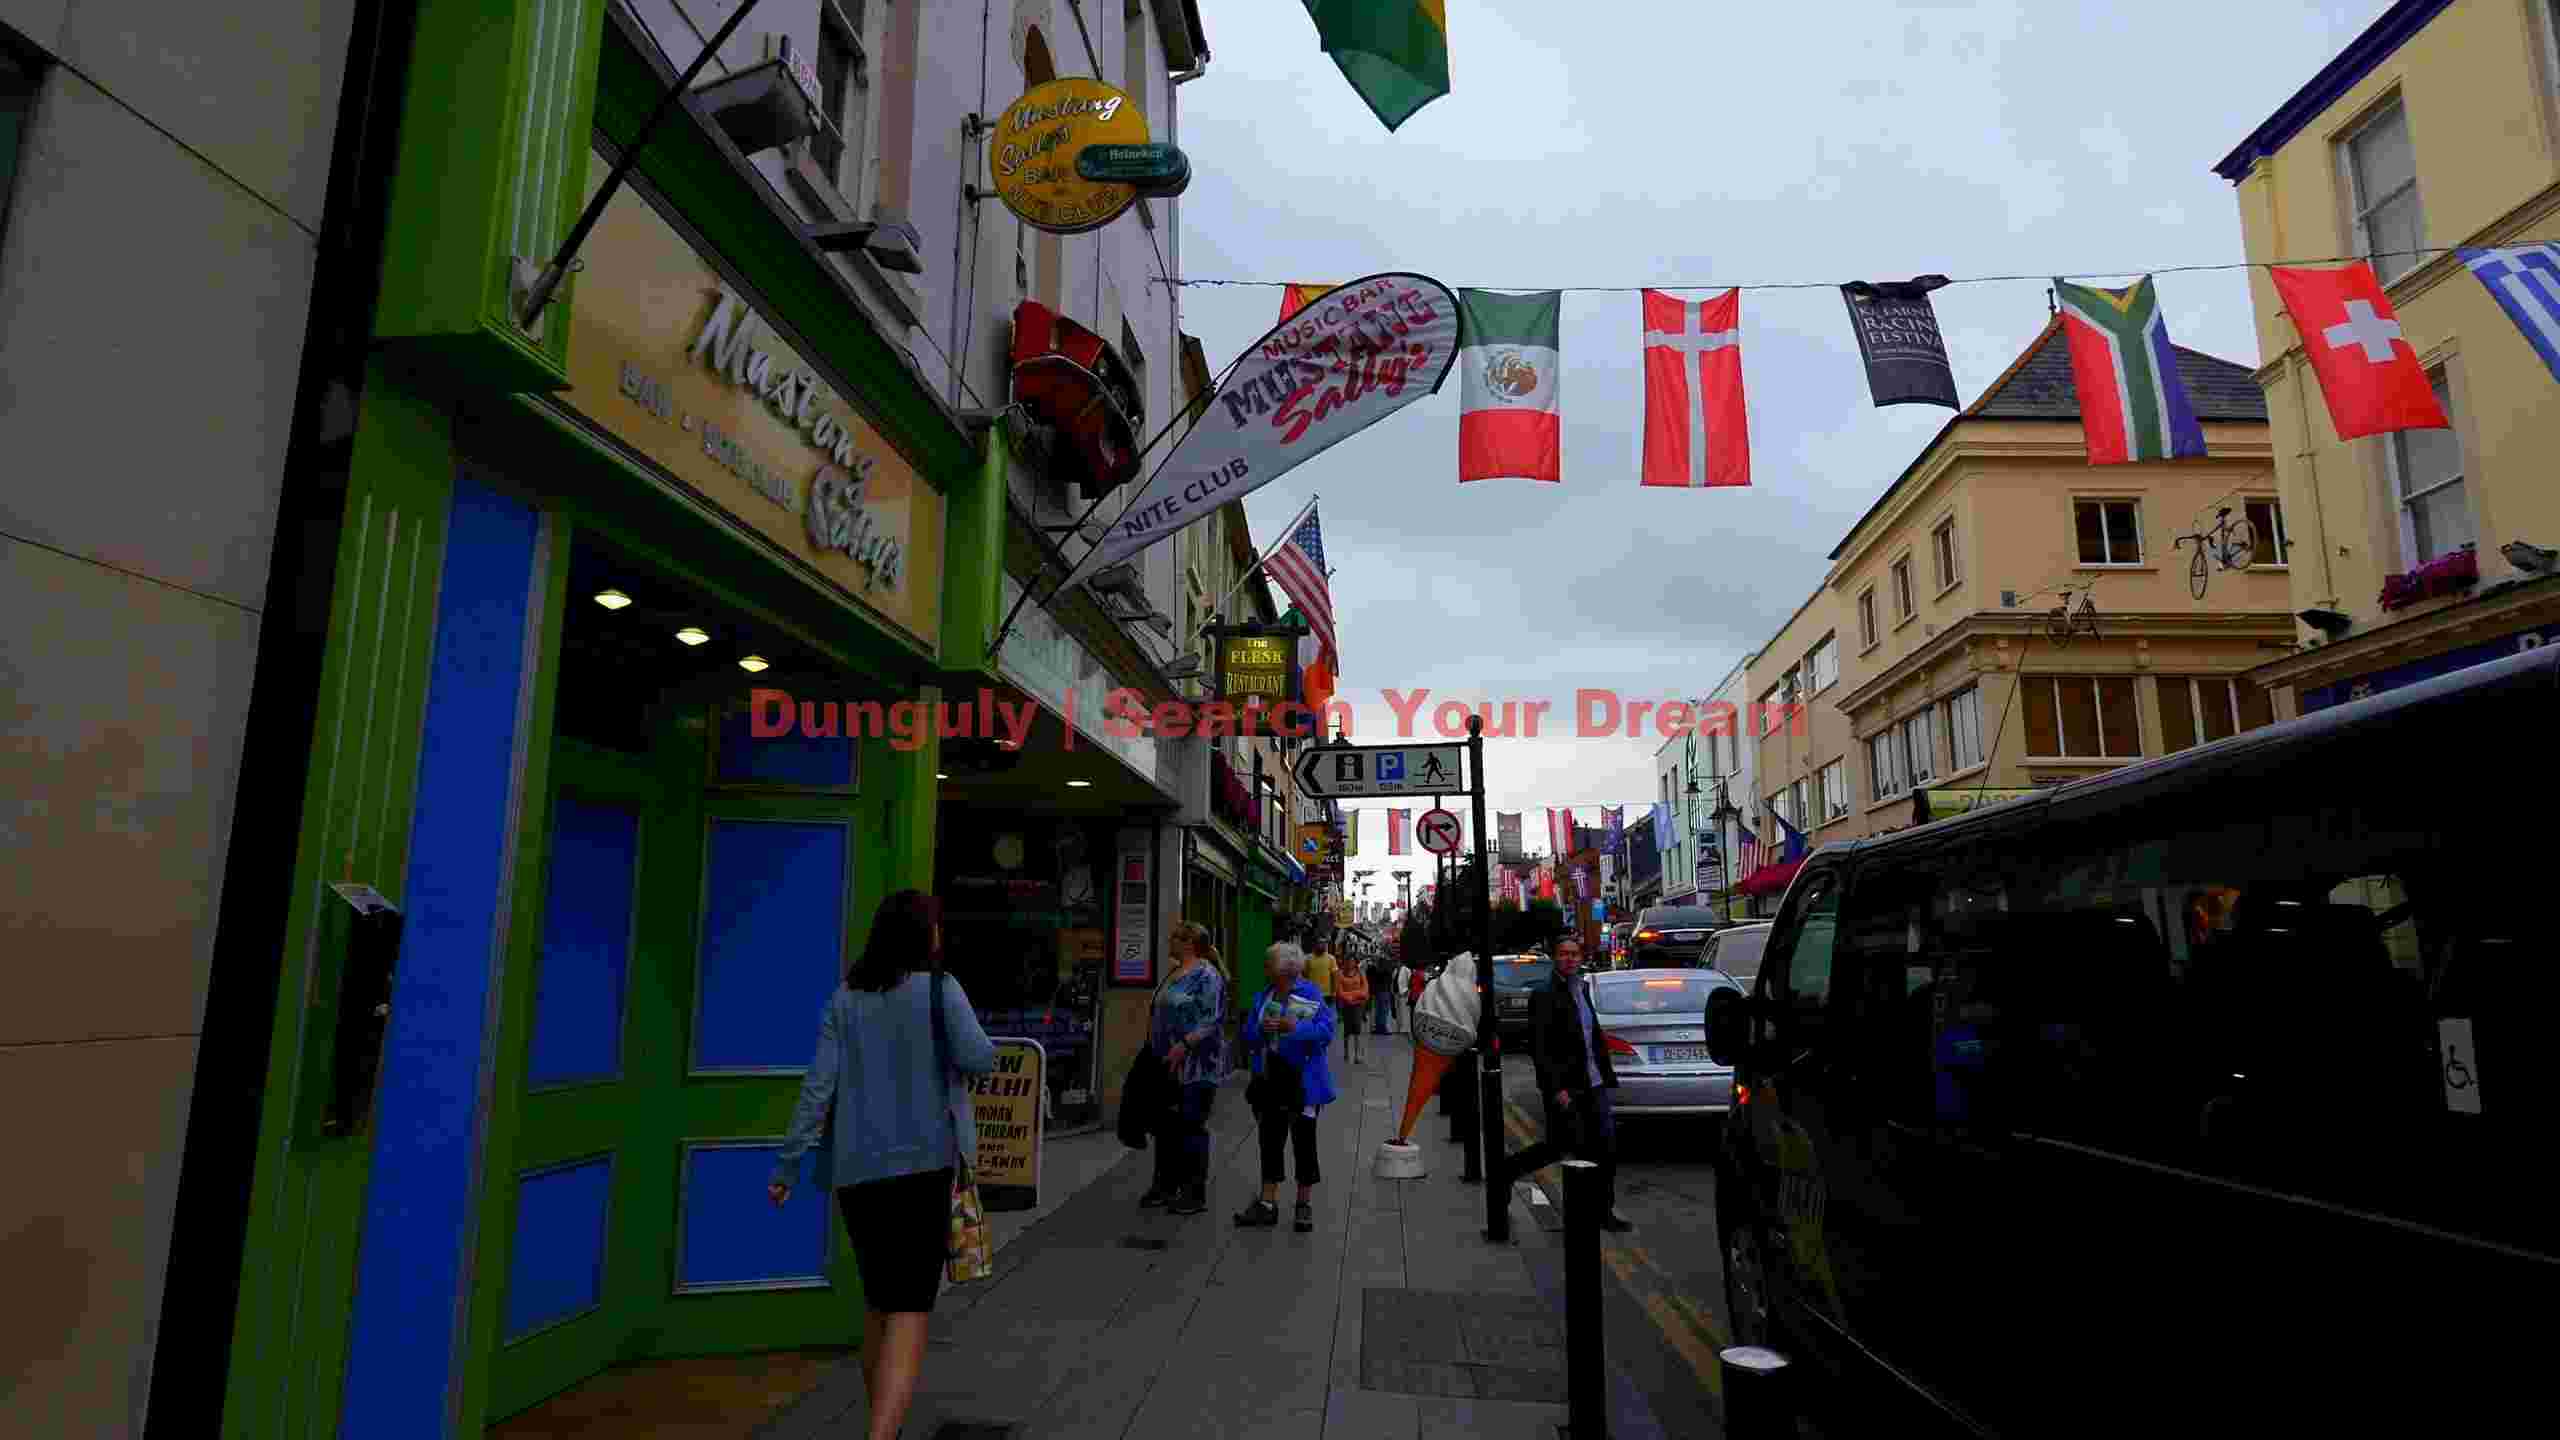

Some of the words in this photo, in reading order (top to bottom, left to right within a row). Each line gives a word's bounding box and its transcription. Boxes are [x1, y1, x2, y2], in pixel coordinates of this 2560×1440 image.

[1008, 90, 1125, 134] Mustang
[1109, 149, 1164, 161] Heineken
[1261, 306, 1341, 361] MUSIC
[1343, 279, 1395, 316] BAR
[1869, 331, 1942, 344] FESTIVA
[1124, 493, 1183, 538] NITE
[1183, 457, 1249, 506] CLUB
